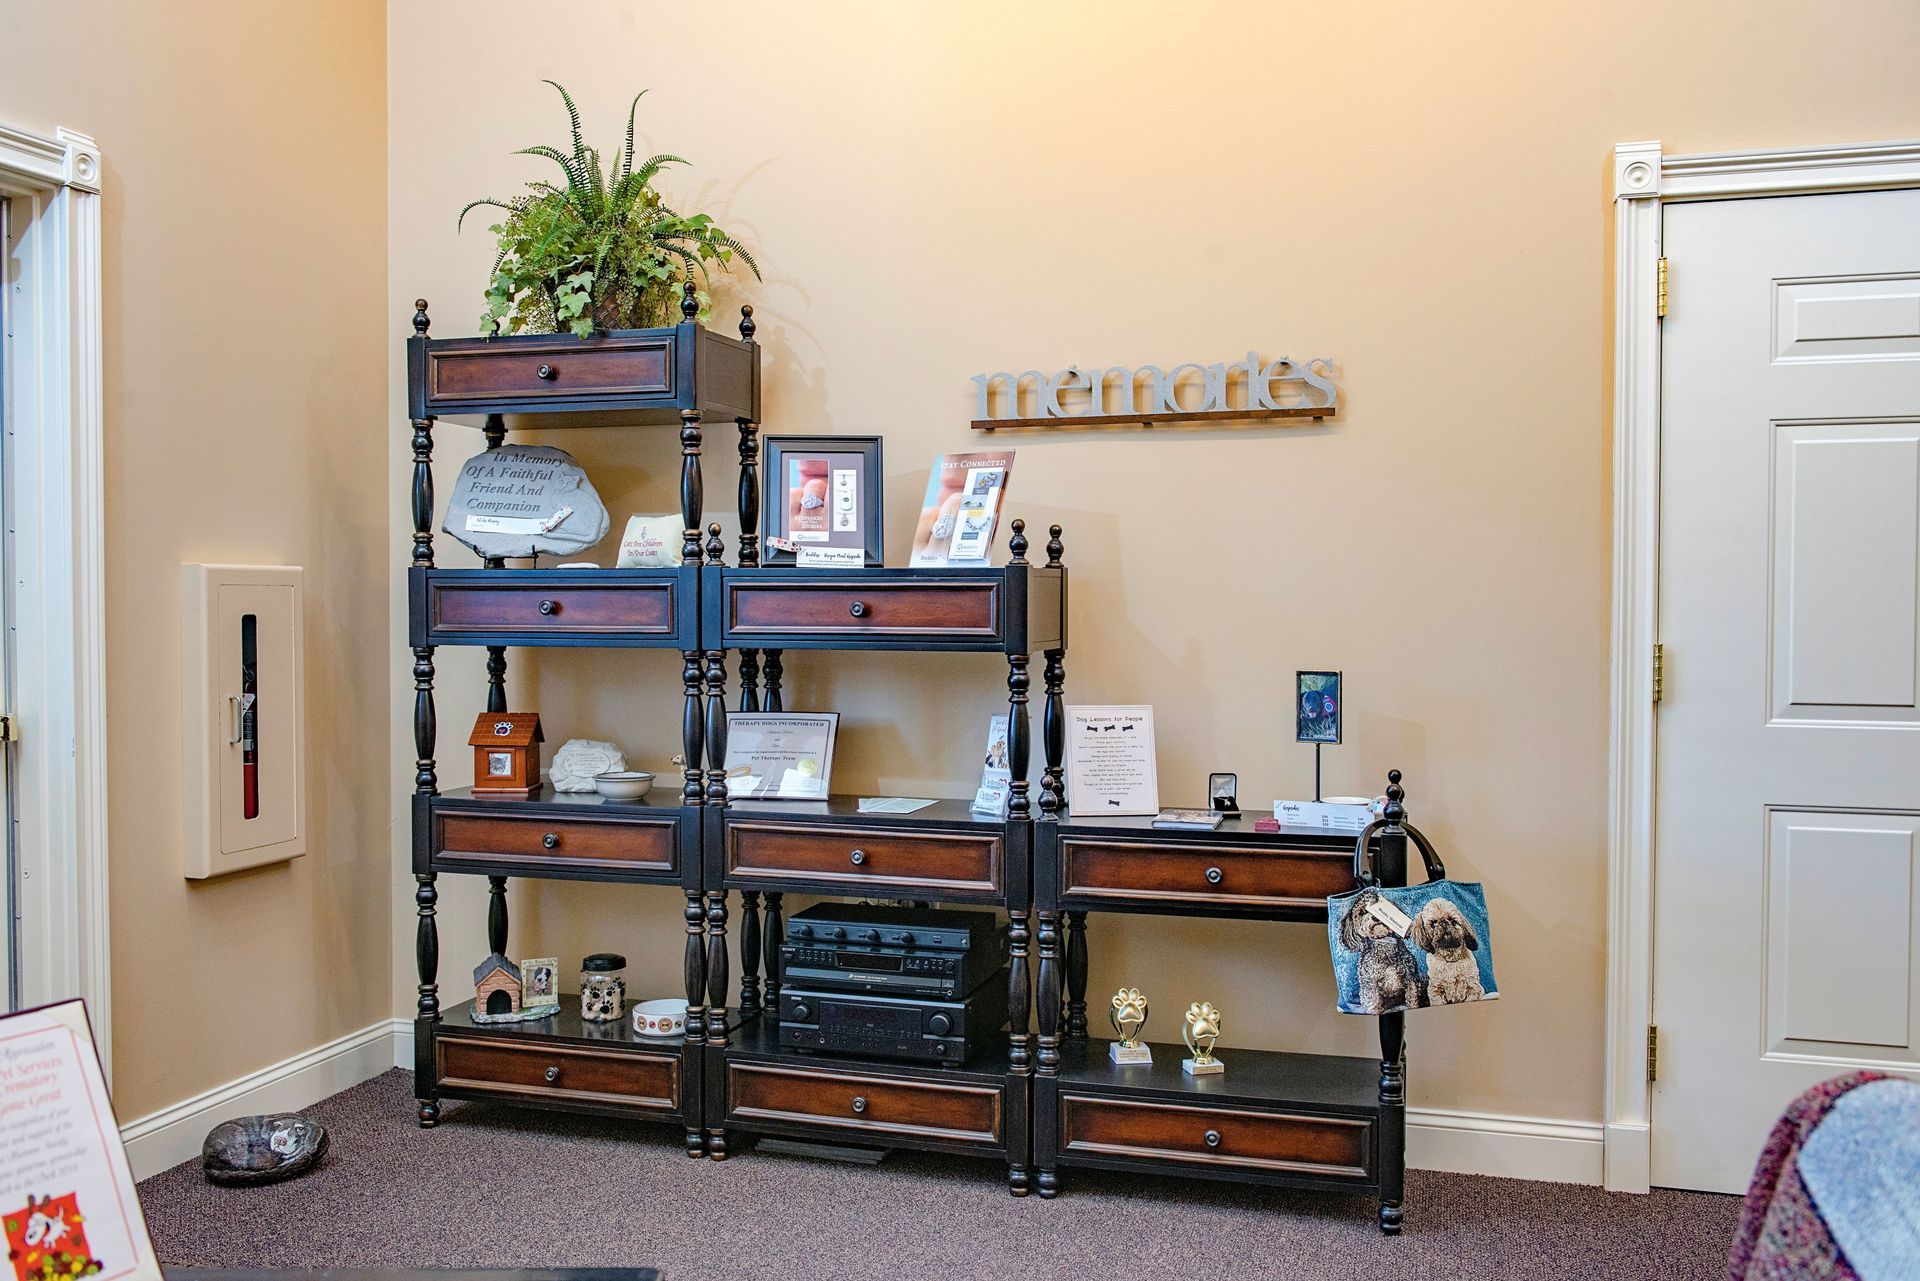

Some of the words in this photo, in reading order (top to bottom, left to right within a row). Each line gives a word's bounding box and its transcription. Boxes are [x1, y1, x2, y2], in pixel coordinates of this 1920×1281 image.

[970, 351, 1336, 419] memories
[493, 452, 509, 462] In
[511, 453, 565, 467] Memory
[960, 460, 1006, 468] CONNECTED
[466, 465, 483, 479] Of
[485, 467, 494, 477] A
[499, 467, 554, 482] Faithful
[469, 482, 513, 495] Friend
[516, 484, 545, 496] And
[467, 498, 541, 512] Companion
[643, 538, 663, 547] Children
[16, 1057, 62, 1074] Services
